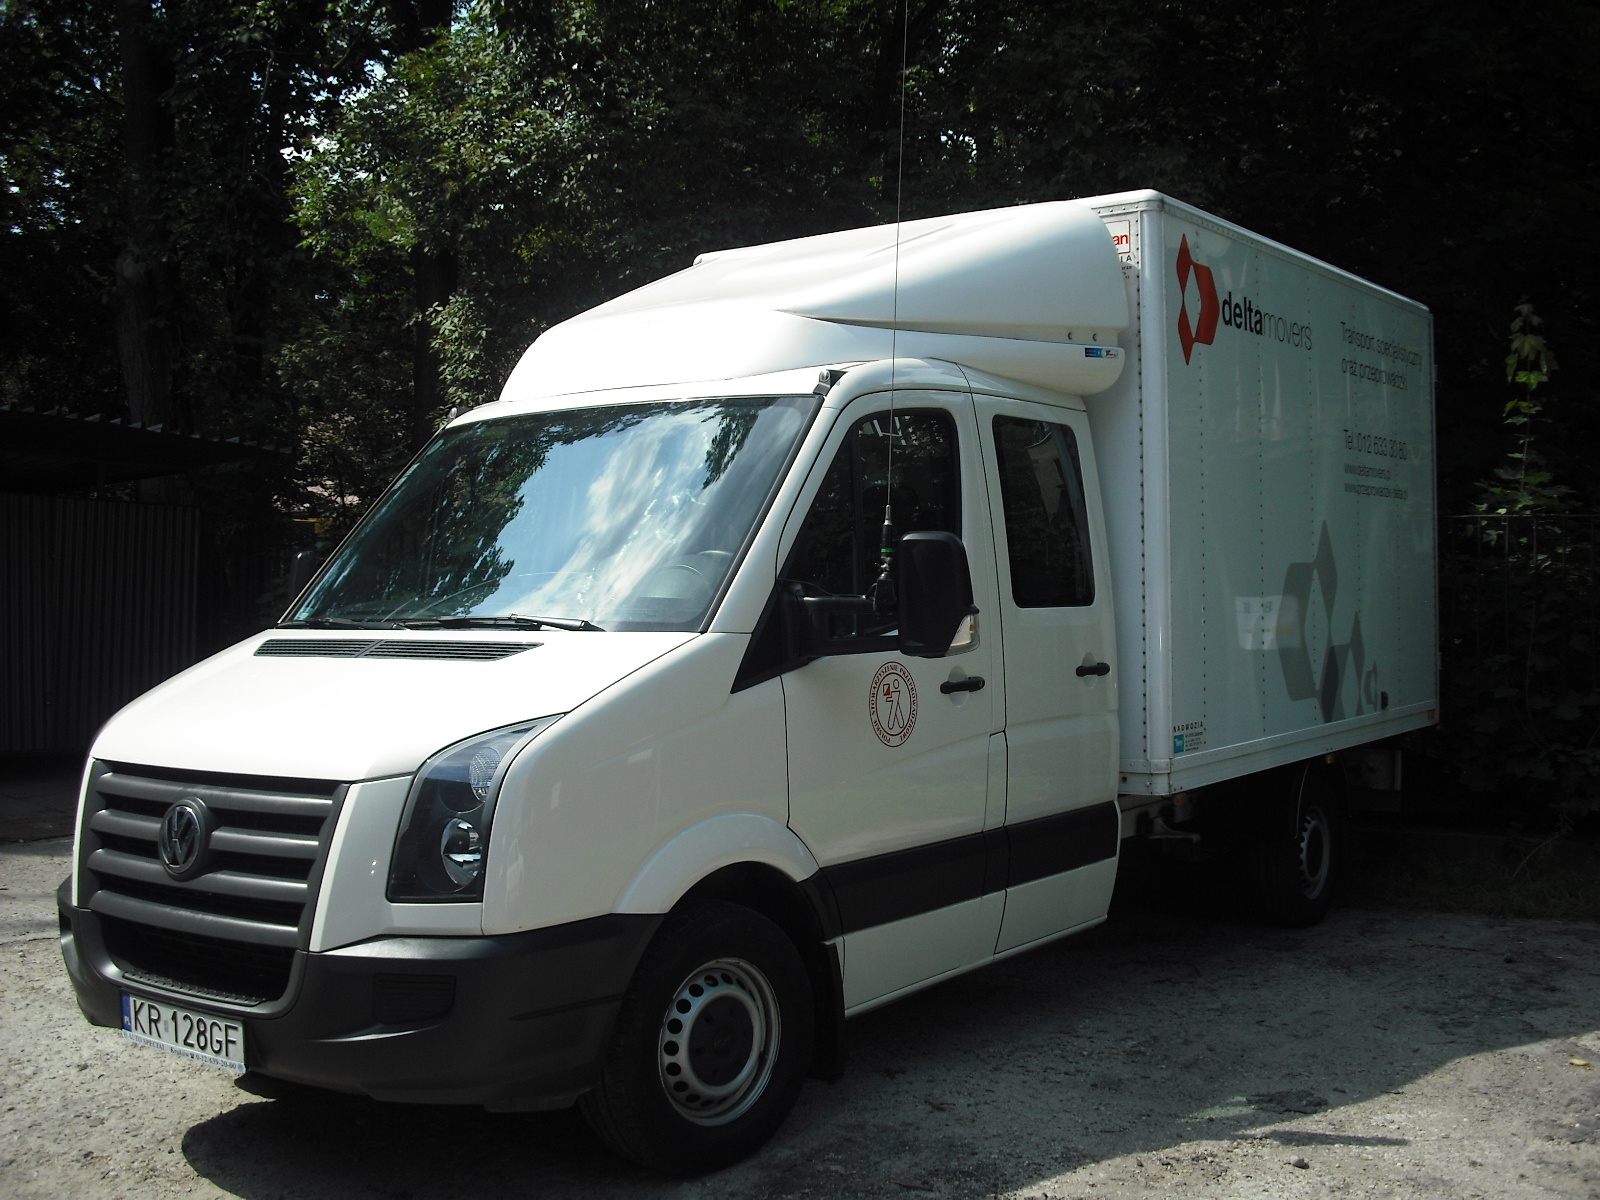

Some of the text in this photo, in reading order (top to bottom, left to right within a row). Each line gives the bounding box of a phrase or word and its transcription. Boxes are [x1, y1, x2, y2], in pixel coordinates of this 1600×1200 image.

[1221, 291, 1312, 351] deltamovers
[1340, 321, 1376, 353] Transport
[1341, 358, 1408, 391] oraz przeprowadzki
[133, 999, 239, 1058] KR 128GF
